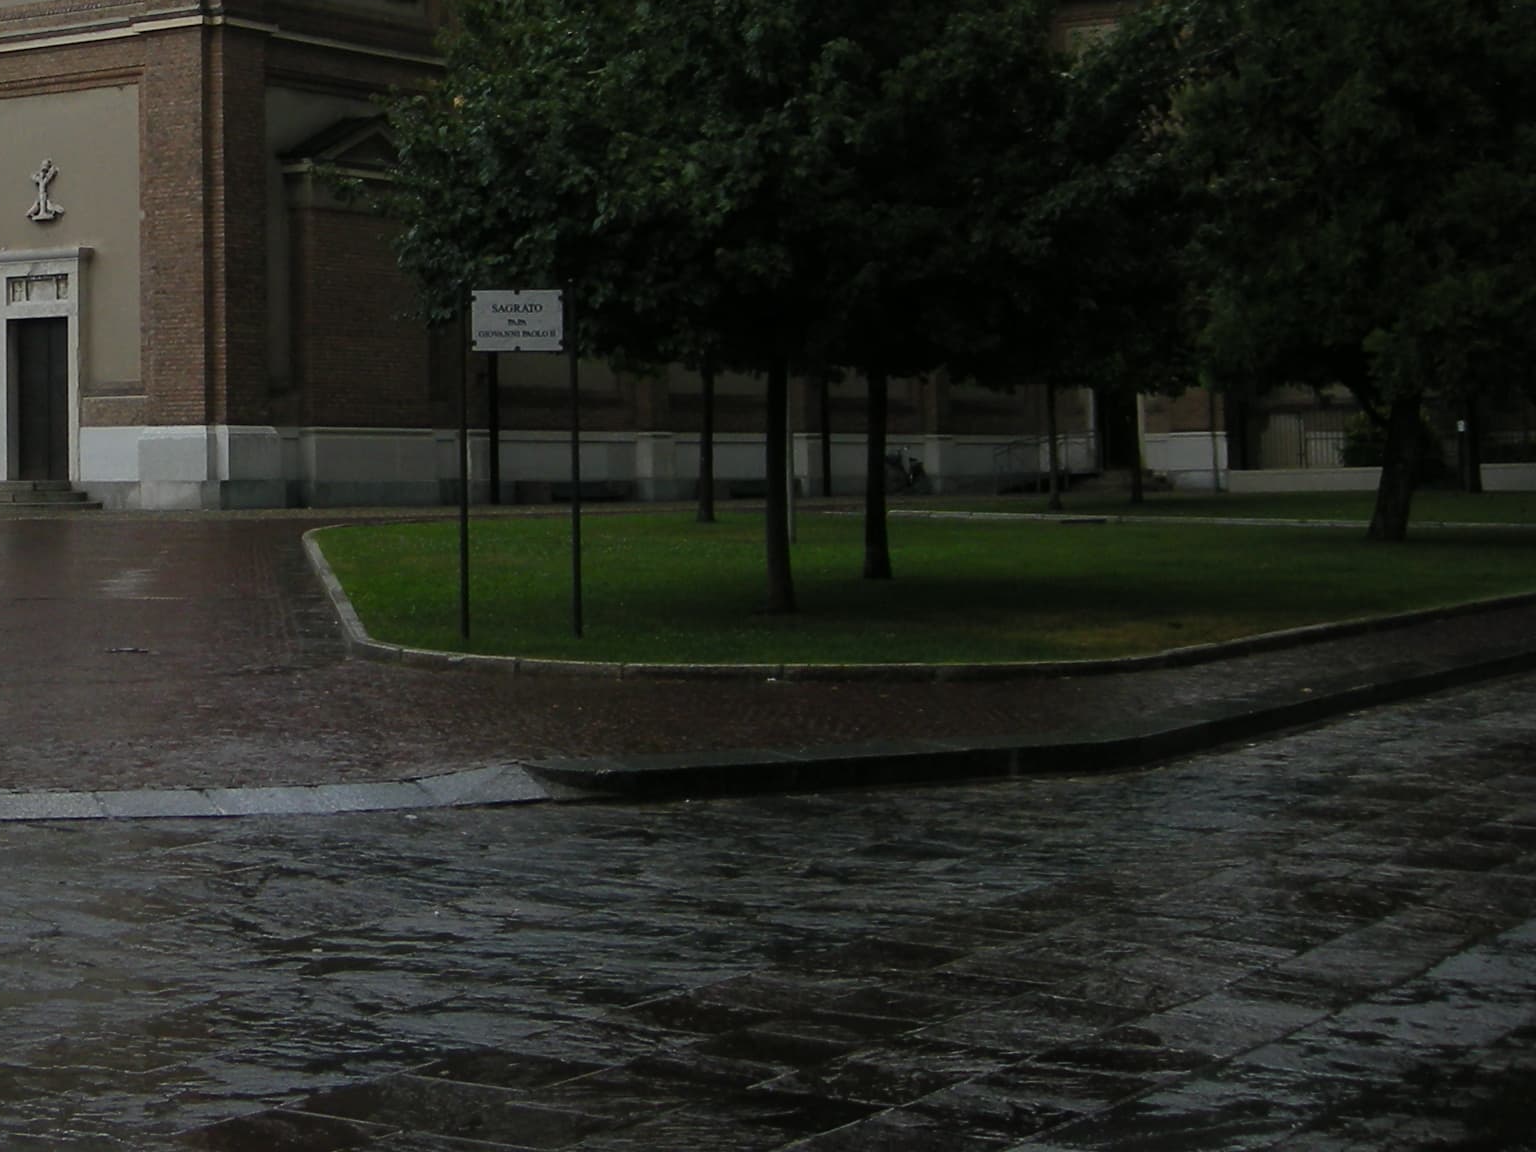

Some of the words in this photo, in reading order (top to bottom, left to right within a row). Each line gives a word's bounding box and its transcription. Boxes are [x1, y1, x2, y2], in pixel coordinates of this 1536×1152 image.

[491, 303, 543, 314] SAGRATO
[478, 330, 521, 338] GIOVANNI
[522, 330, 549, 338] PAOLO
